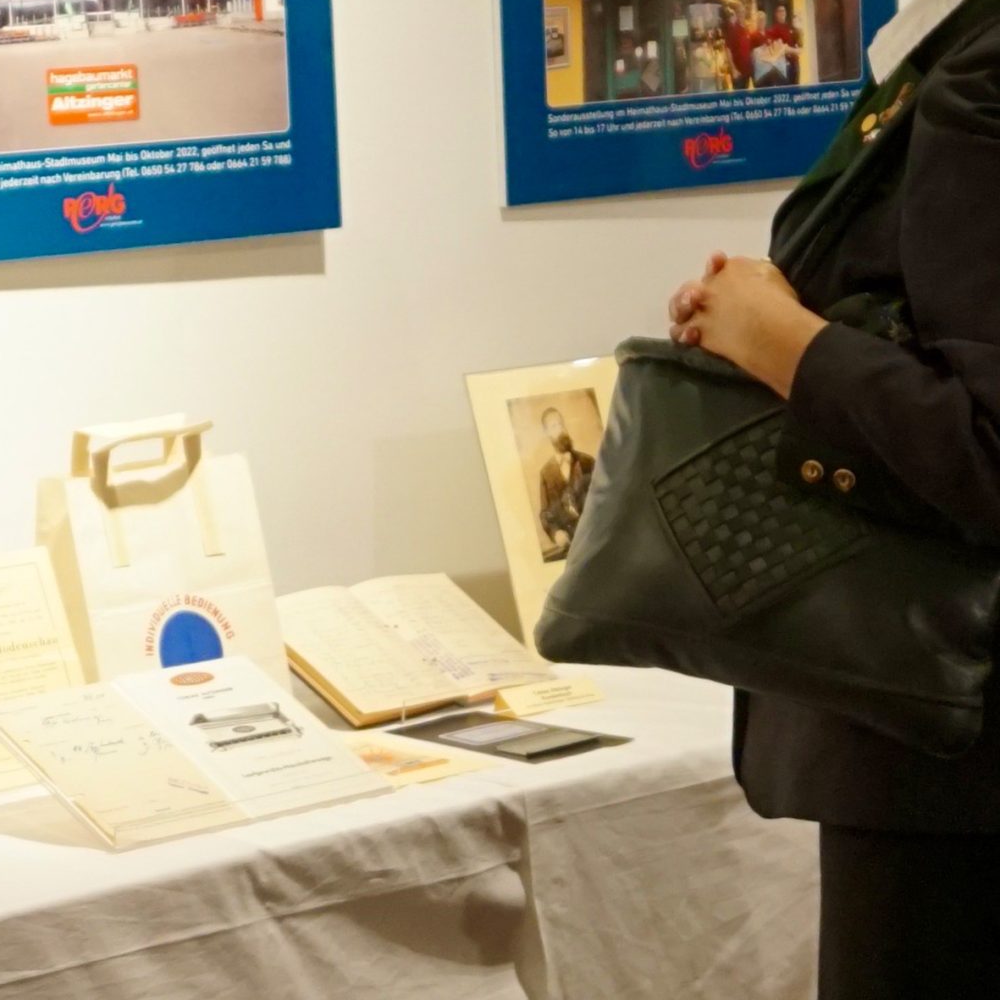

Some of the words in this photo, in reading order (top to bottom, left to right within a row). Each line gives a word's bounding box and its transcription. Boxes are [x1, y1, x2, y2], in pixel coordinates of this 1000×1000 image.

[52, 94, 134, 111] Altzinger
[106, 151, 122, 163] Mai
[124, 149, 138, 162] bis
[140, 147, 174, 161] Oktober
[200, 142, 236, 158] geöffnet
[237, 140, 260, 155] jeden
[261, 139, 273, 151] Sa
[274, 138, 290, 150] und
[0, 174, 38, 190] jederzeit
[40, 172, 60, 185] nach
[62, 167, 120, 185] Vereinbarung
[163, 162, 175, 175] 54
[176, 161, 188, 174] 27
[206, 158, 224, 171] oder
[248, 155, 258, 168] 21
[145, 594, 181, 656] INDIVIDUELLE
[184, 594, 235, 640] BEDIENUNG
